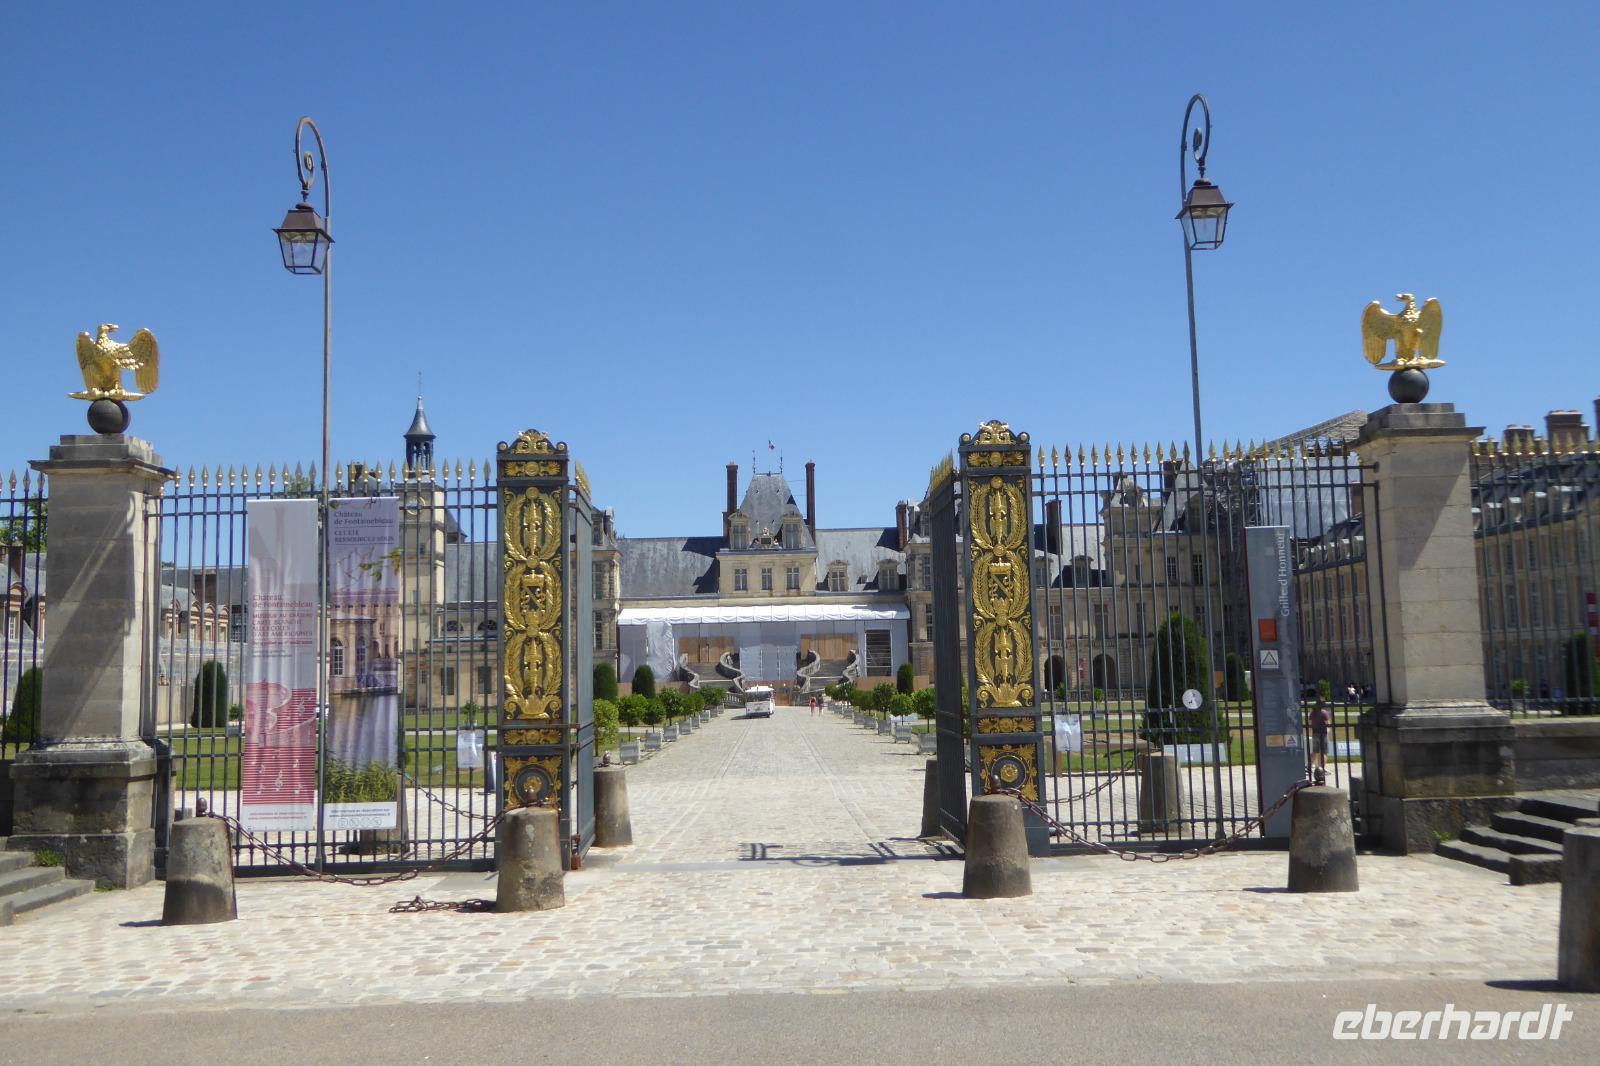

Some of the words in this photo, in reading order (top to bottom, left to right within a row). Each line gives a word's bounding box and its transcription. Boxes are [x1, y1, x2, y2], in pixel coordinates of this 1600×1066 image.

[344, 517, 394, 525] Fontainebleau
[1277, 531, 1288, 586] d'Honneur
[1279, 589, 1290, 617] Grille
